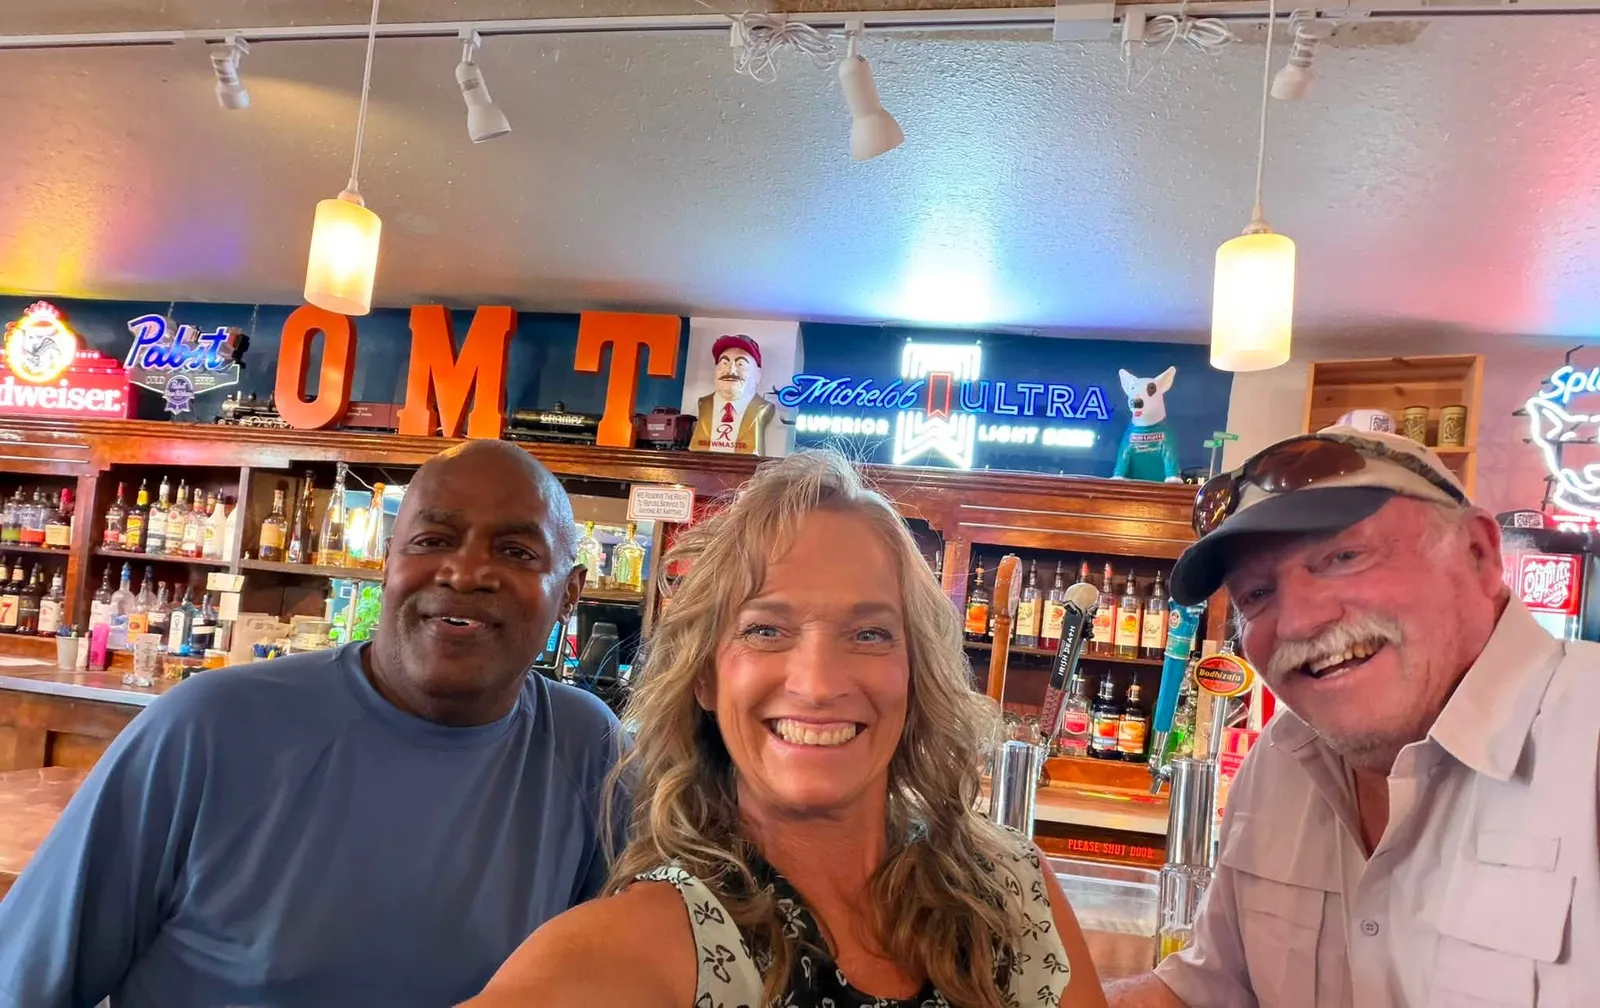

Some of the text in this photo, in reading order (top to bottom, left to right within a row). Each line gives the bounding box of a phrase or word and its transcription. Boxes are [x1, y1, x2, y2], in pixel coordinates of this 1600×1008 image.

[123, 314, 230, 370] Pabst
[778, 374, 1109, 420] Michelob ULTRA
[1539, 366, 1600, 404] Spl
[540, 413, 585, 425] GRAMPS
[716, 423, 733, 441] R
[795, 413, 889, 436] SUPERIOR
[978, 424, 1038, 444] LIGHT
[1058, 653, 1068, 676] IRISH
[1064, 625, 1076, 654] DEATH
[1068, 839, 1099, 852] PLEASE
[1103, 843, 1126, 855] SHUT
